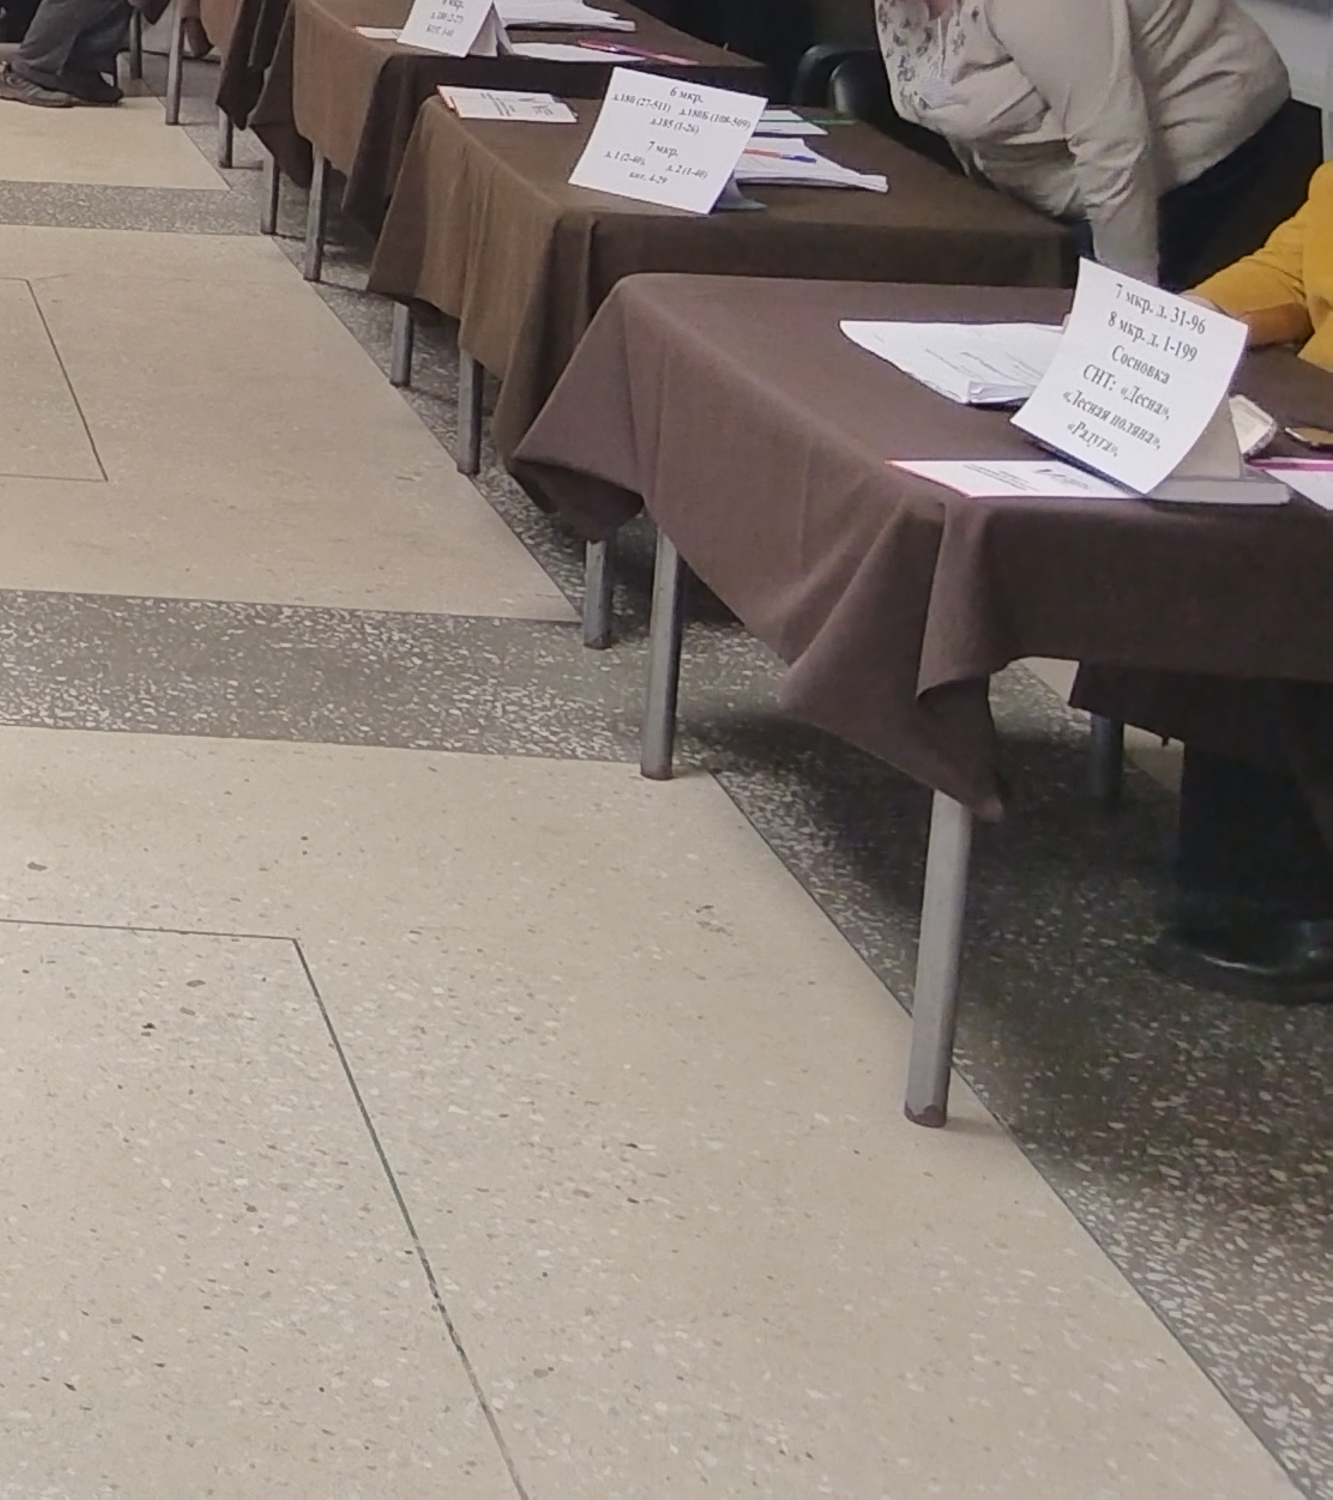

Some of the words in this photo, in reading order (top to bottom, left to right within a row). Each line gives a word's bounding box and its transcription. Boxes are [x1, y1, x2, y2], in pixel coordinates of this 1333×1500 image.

[669, 86, 678, 97] 6
[678, 89, 704, 105] мкр.
[647, 141, 655, 151] 7
[655, 143, 679, 159] мкр.
[1116, 283, 1124, 299] 7
[1125, 293, 1153, 315] мкр.
[1156, 306, 1167, 320] д.
[1170, 307, 1207, 335] 31-96
[1107, 311, 1118, 328] 8
[1119, 319, 1145, 344] мкр.
[1147, 332, 1159, 349] д.
[1164, 335, 1198, 363] 1-199
[1111, 344, 1170, 386] Сосновка
[1083, 363, 1116, 392] СНТ:
[1120, 385, 1170, 421] «Десна»,
[1063, 389, 1111, 422] «Лесная
[1111, 411, 1162, 450] поляна»,
